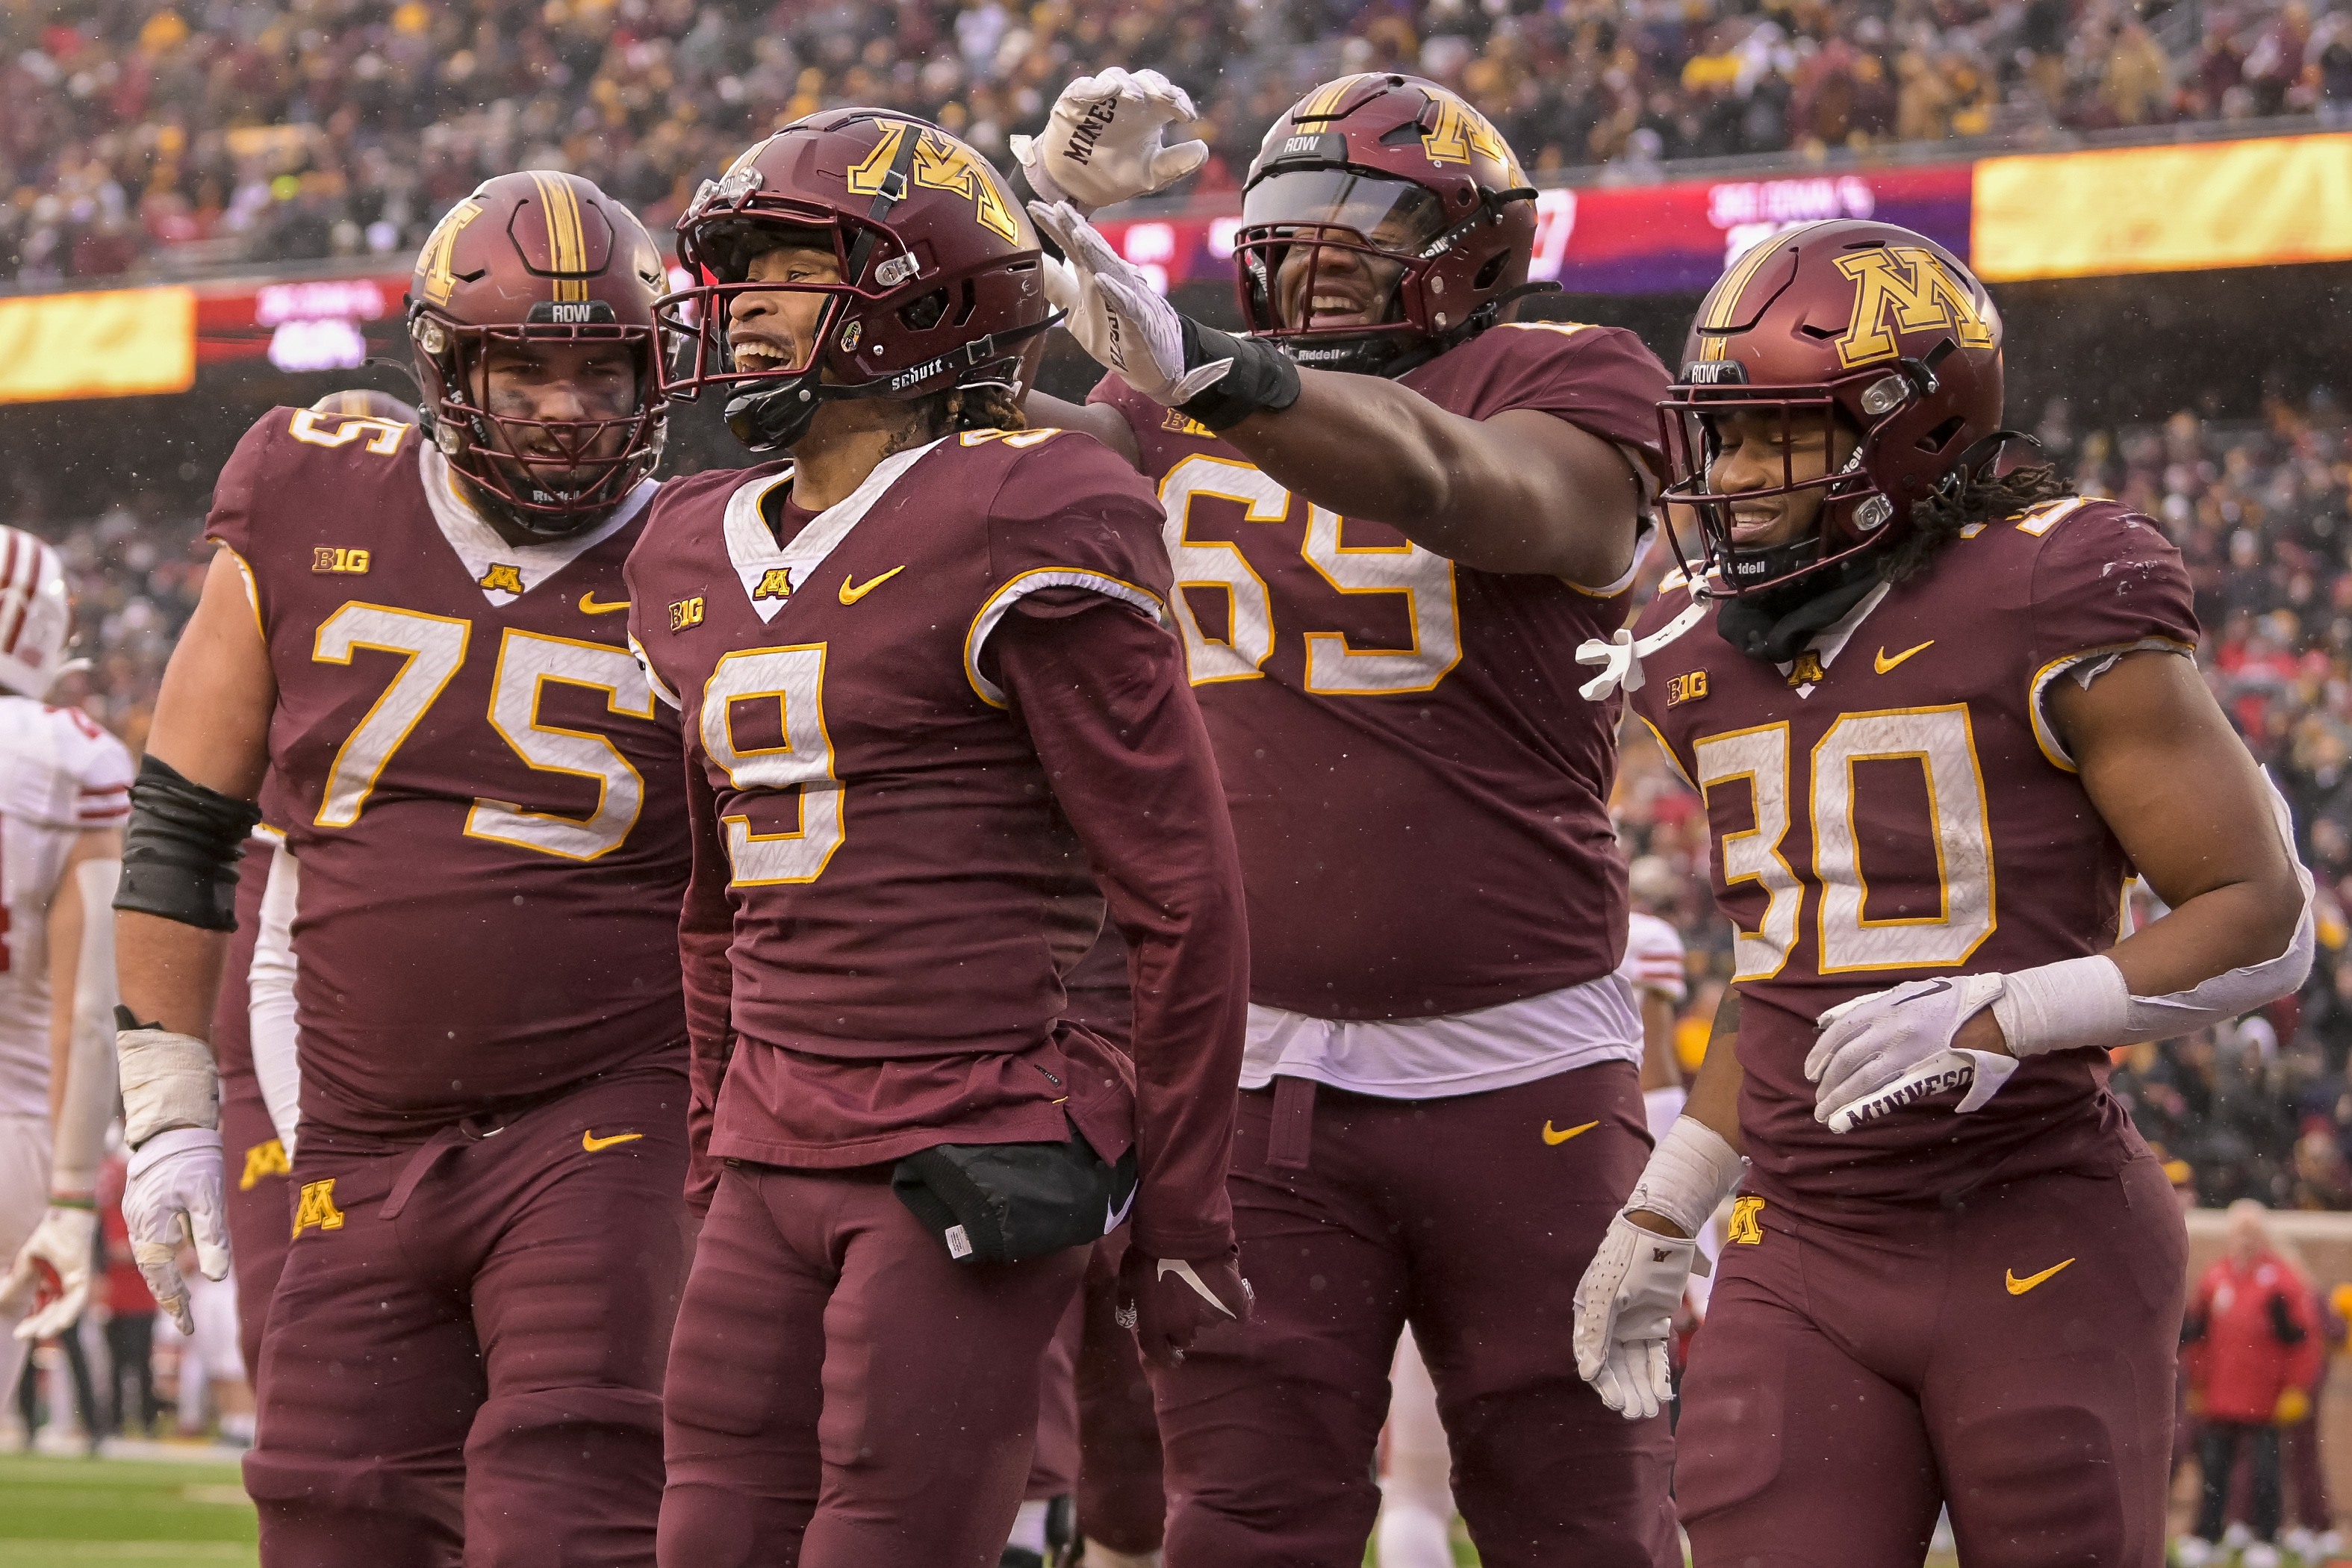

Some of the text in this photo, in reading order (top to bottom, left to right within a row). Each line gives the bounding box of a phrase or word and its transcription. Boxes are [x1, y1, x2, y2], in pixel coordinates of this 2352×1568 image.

[1284, 136, 1320, 153] ROW
[847, 117, 1018, 247] M
[553, 305, 590, 323] ROW
[1832, 246, 1994, 369] M
[1298, 349, 1340, 361] Riddell
[1691, 364, 1720, 384] ROW
[481, 563, 523, 594] M
[753, 569, 791, 599] M
[1787, 653, 1823, 686] M
[311, 600, 656, 861] 75
[700, 641, 846, 887] 9
[1693, 703, 1997, 983] 30
[292, 1177, 346, 1239] M
